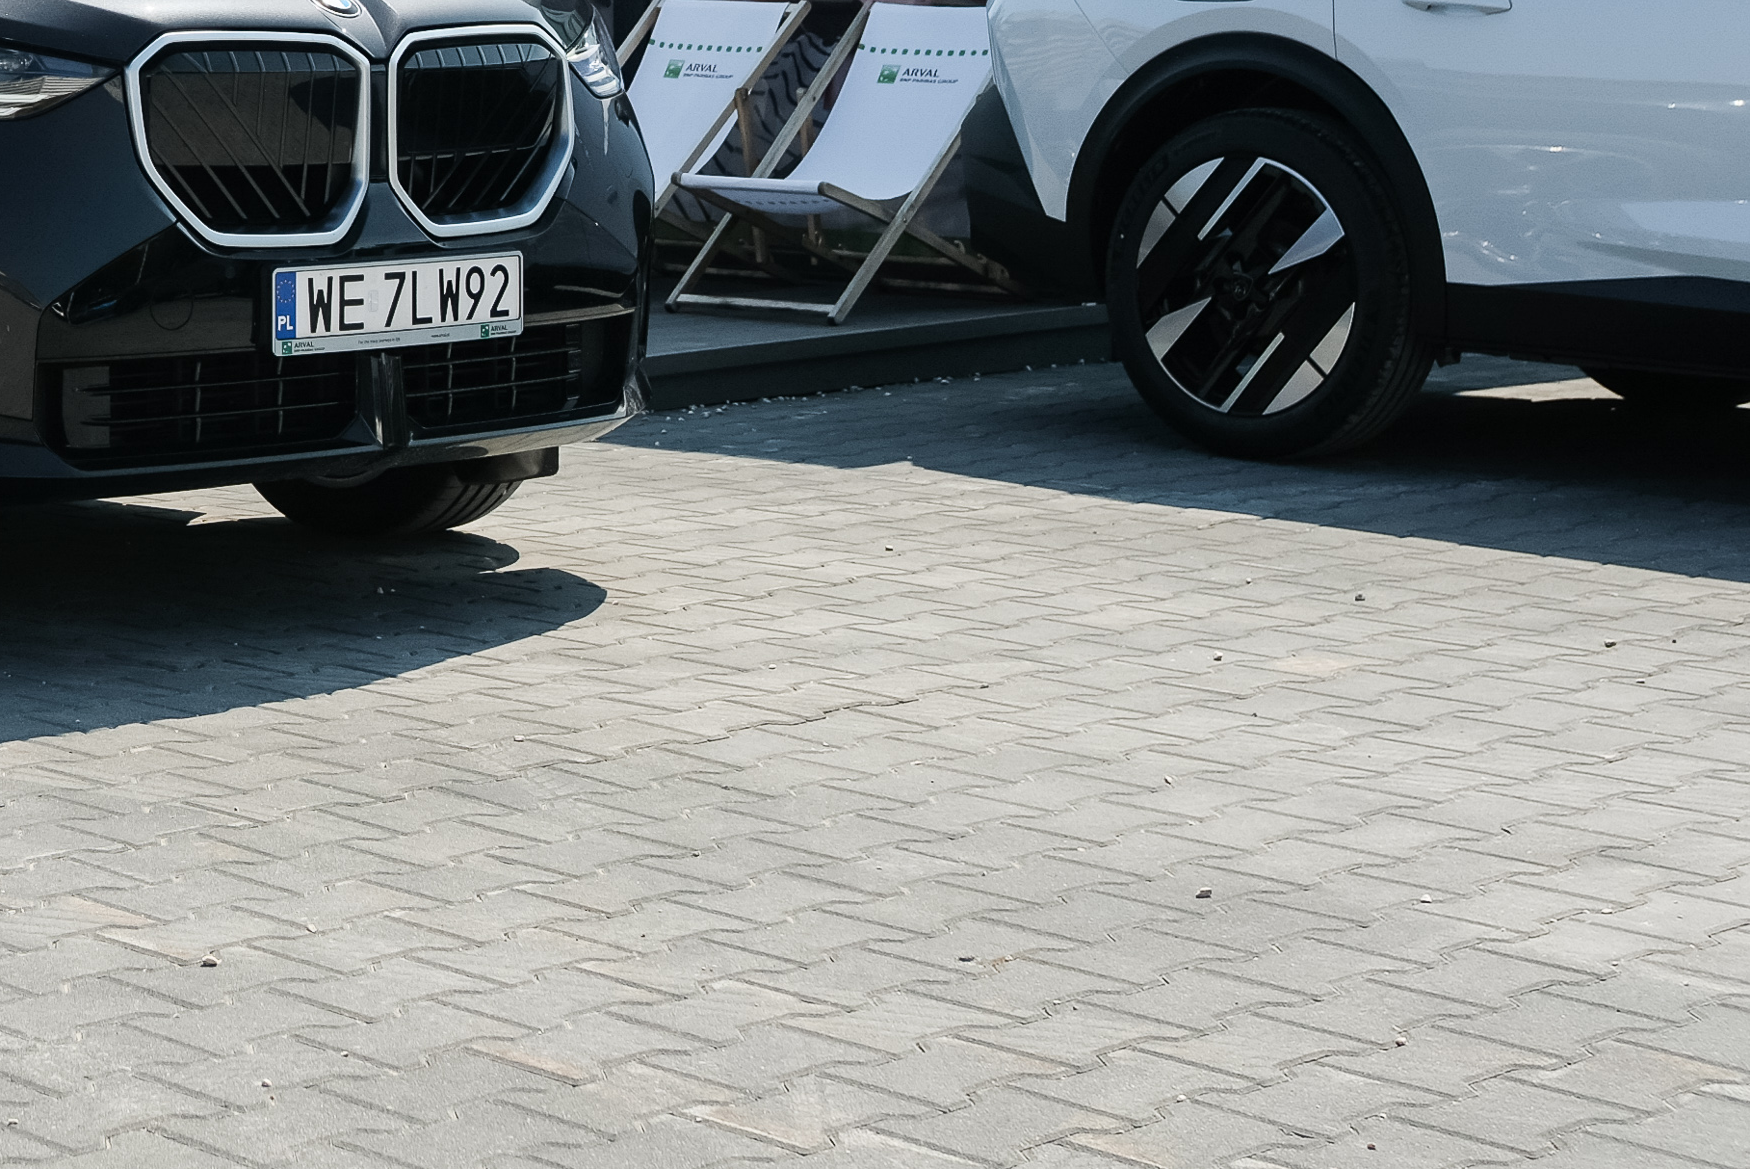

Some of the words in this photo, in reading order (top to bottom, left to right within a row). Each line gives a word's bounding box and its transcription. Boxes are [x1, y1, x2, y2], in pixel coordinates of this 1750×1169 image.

[686, 63, 717, 73] ARVAL
[902, 67, 939, 78] ARVAL
[307, 274, 365, 333] WE
[384, 264, 510, 328] 7LW92
[277, 315, 294, 332] PL
